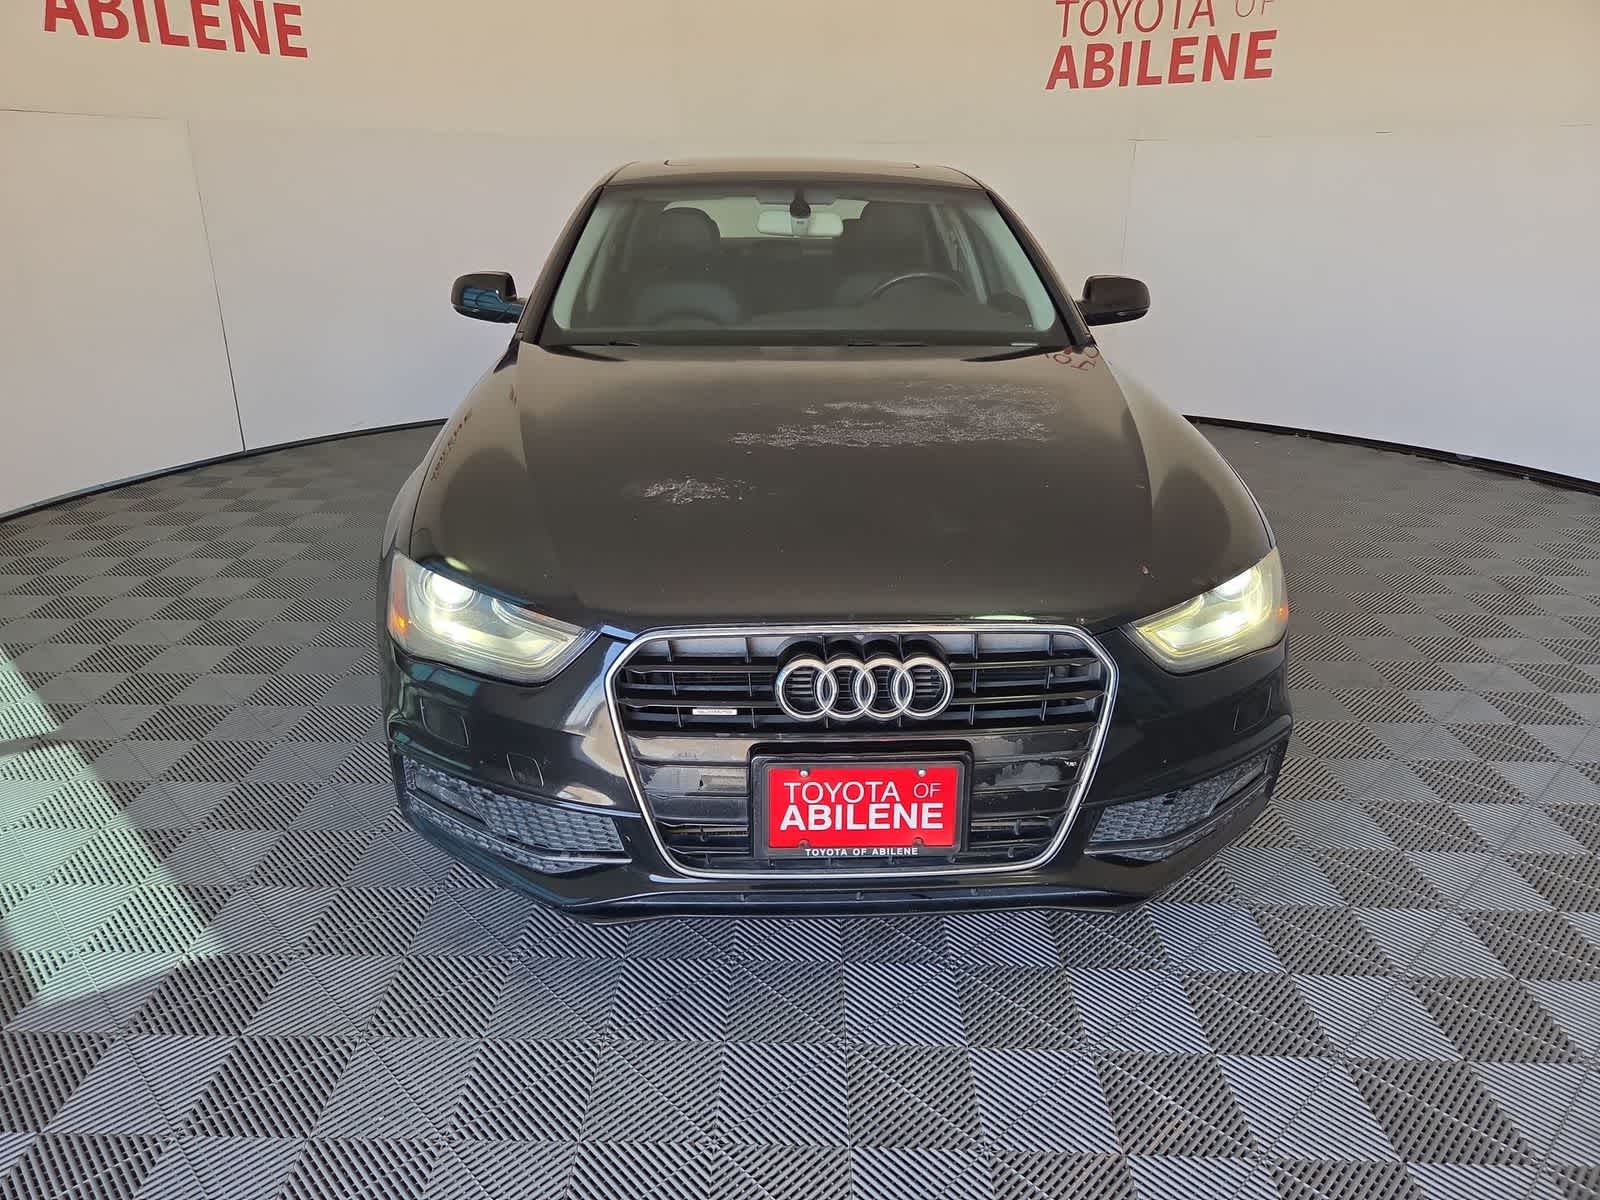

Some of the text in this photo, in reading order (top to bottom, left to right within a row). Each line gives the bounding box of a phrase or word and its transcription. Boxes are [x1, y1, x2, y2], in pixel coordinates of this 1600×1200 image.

[43, 0, 309, 58] ABILENE
[1056, 0, 1216, 38] TOYOTA
[1045, 29, 1278, 90] ABILENE
[783, 781, 942, 804] TOYOTA OF
[779, 802, 944, 831] ABILENE
[805, 847, 918, 856] TOYOTA OF ABILENE
